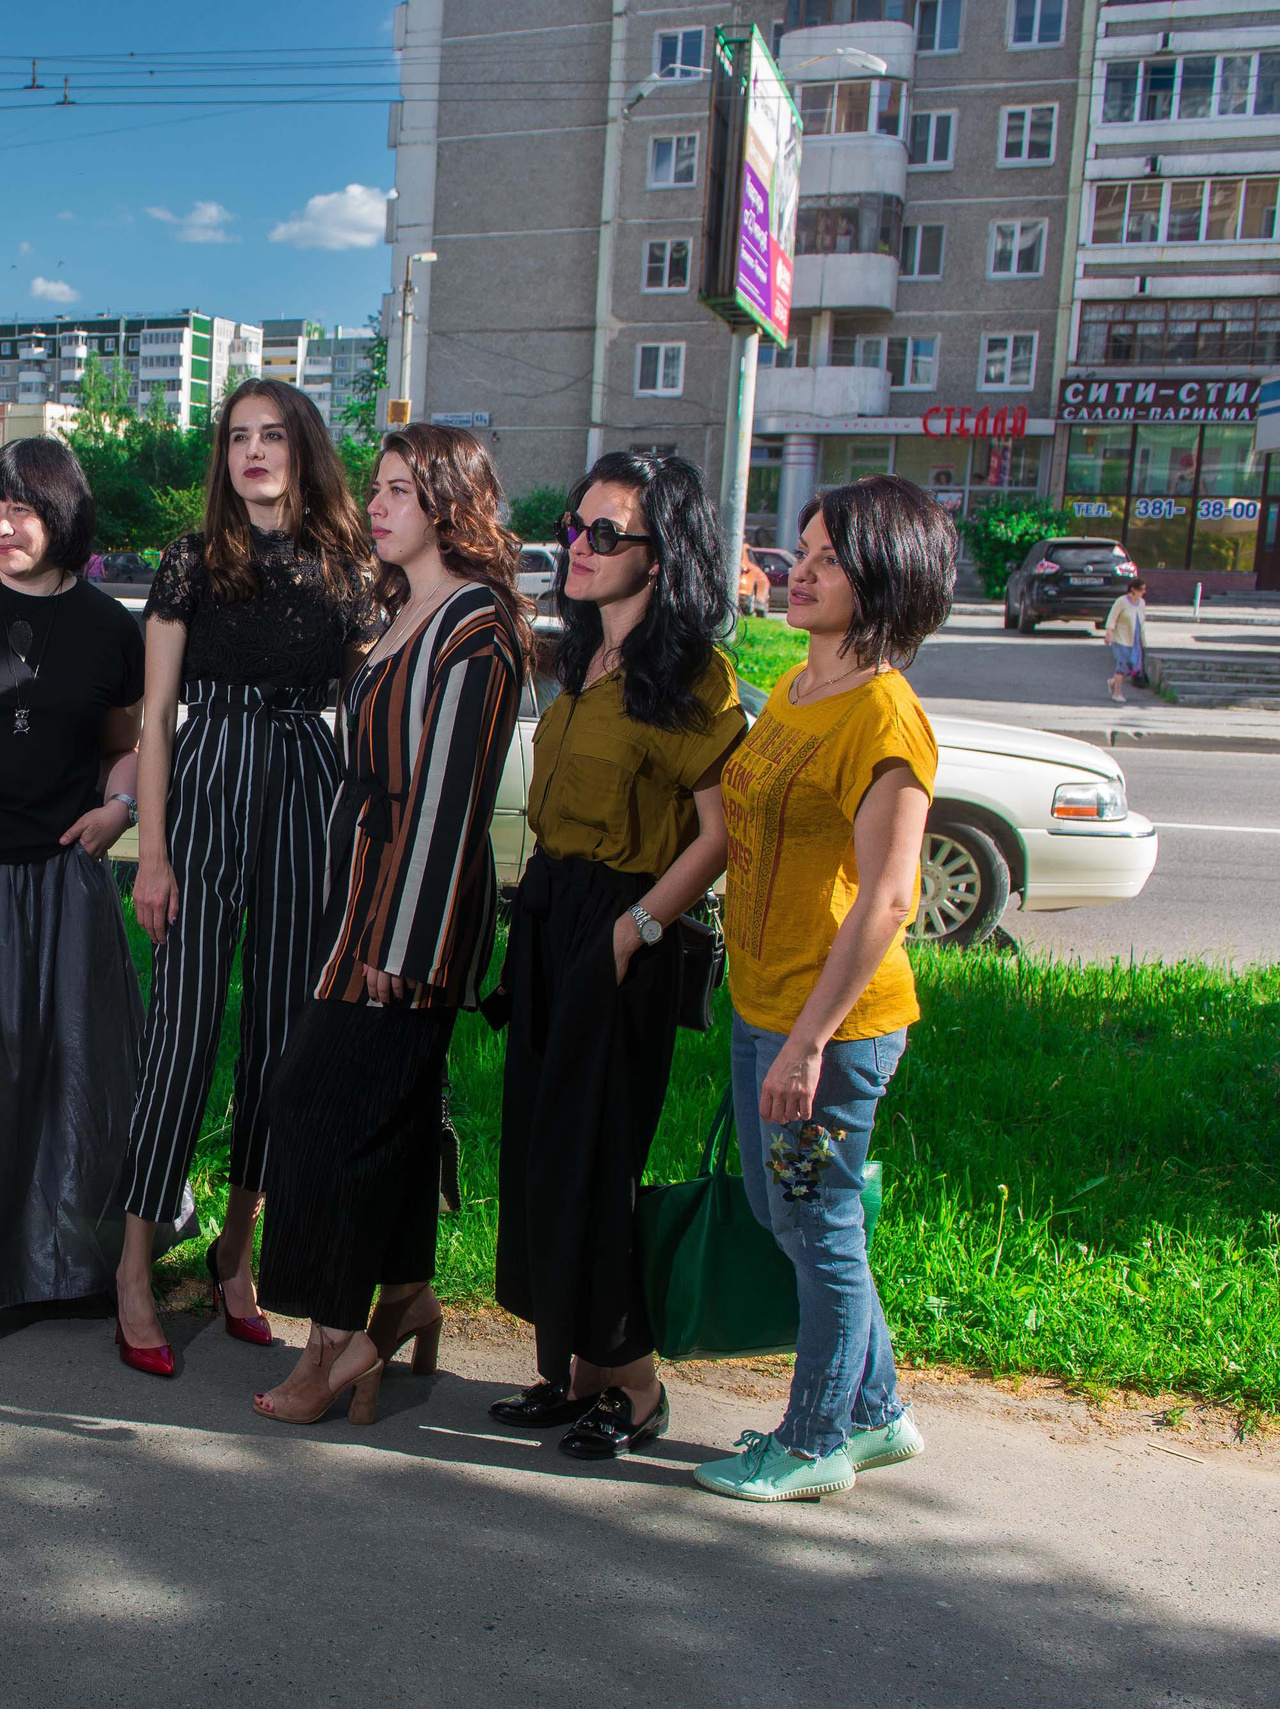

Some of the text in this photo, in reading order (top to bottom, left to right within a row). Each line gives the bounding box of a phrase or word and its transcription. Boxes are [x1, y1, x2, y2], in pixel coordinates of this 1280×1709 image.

[1062, 407, 1253, 420] САЛОН-ПАРИКМА
[1197, 499, 1259, 520] 38-00
[721, 757, 757, 801] HINK
